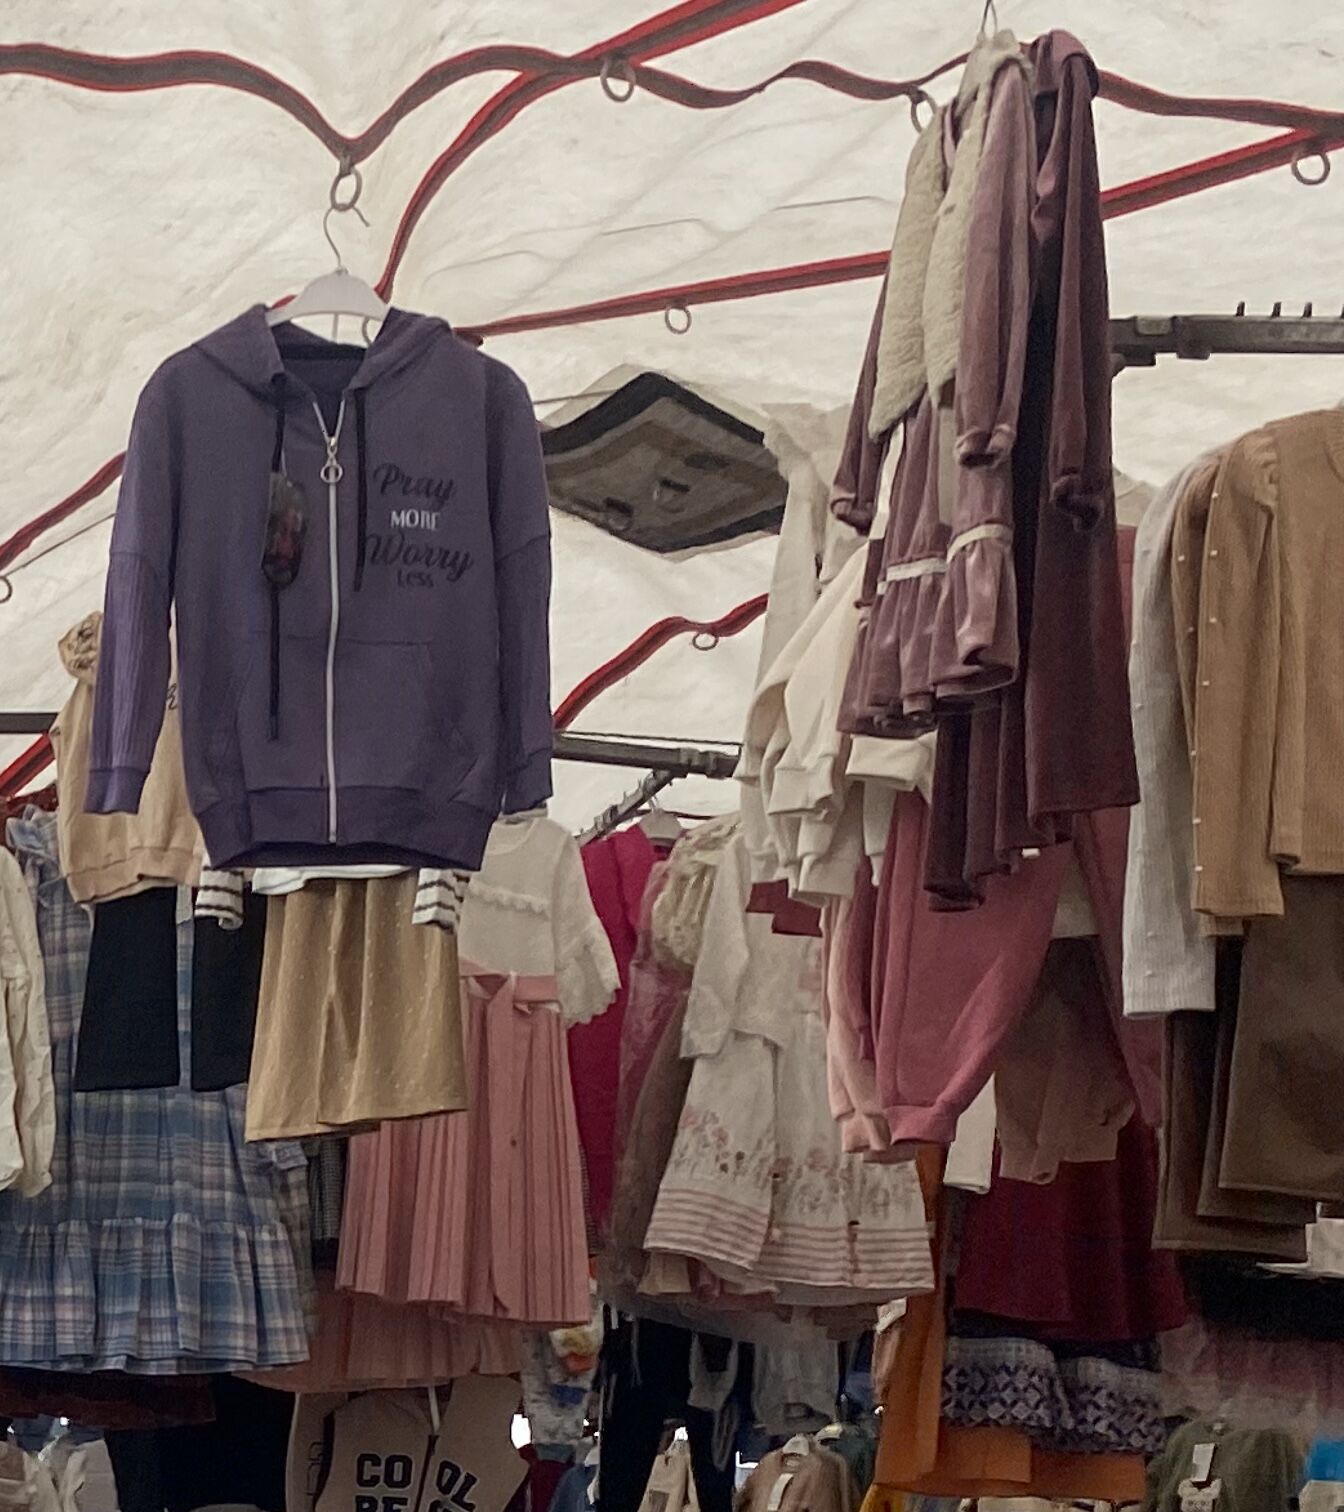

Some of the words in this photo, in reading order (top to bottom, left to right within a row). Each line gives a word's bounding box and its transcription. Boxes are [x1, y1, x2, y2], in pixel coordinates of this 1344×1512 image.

[373, 462, 456, 511] Pray
[390, 508, 441, 530] MORE
[365, 529, 474, 583] Worry
